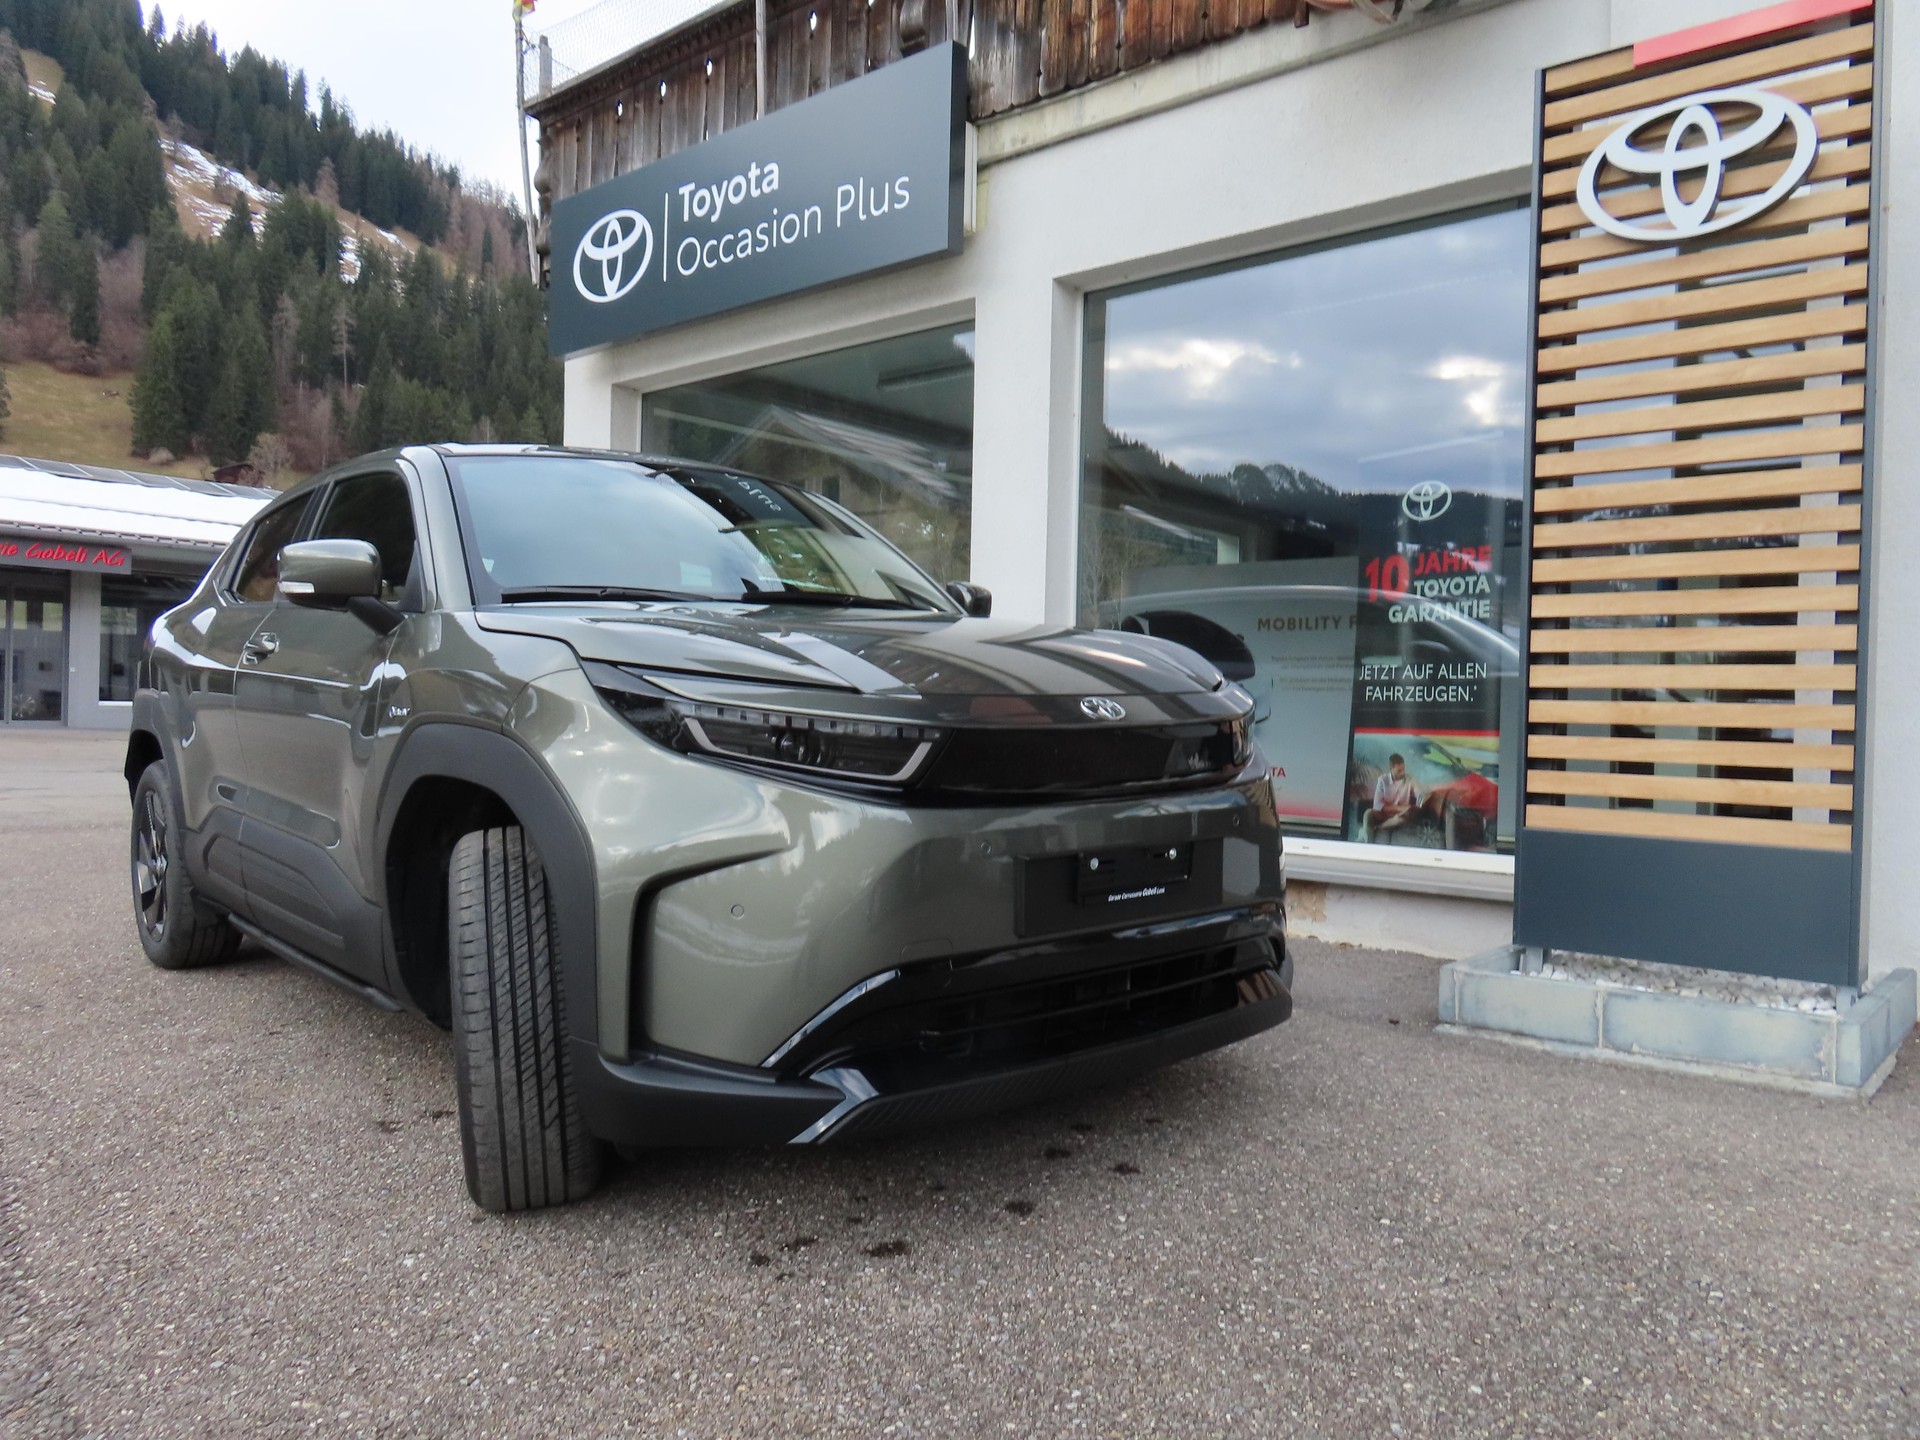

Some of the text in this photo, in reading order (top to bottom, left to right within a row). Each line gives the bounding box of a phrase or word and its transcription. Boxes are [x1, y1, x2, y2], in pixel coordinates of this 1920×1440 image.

[677, 161, 780, 223] Toyota
[676, 175, 911, 276] Occasion Plus
[25, 542, 88, 563] Gobeli
[92, 549, 126, 567] AG
[1365, 545, 1492, 603] 10 JAHRE
[1414, 574, 1491, 598] TOYOTA
[1257, 615, 1342, 632] MOBILITY
[1388, 599, 1491, 624] GARANTIE
[1359, 664, 1398, 681] JETZT
[1402, 663, 1434, 680] AUF
[1437, 662, 1488, 680] ALLEN
